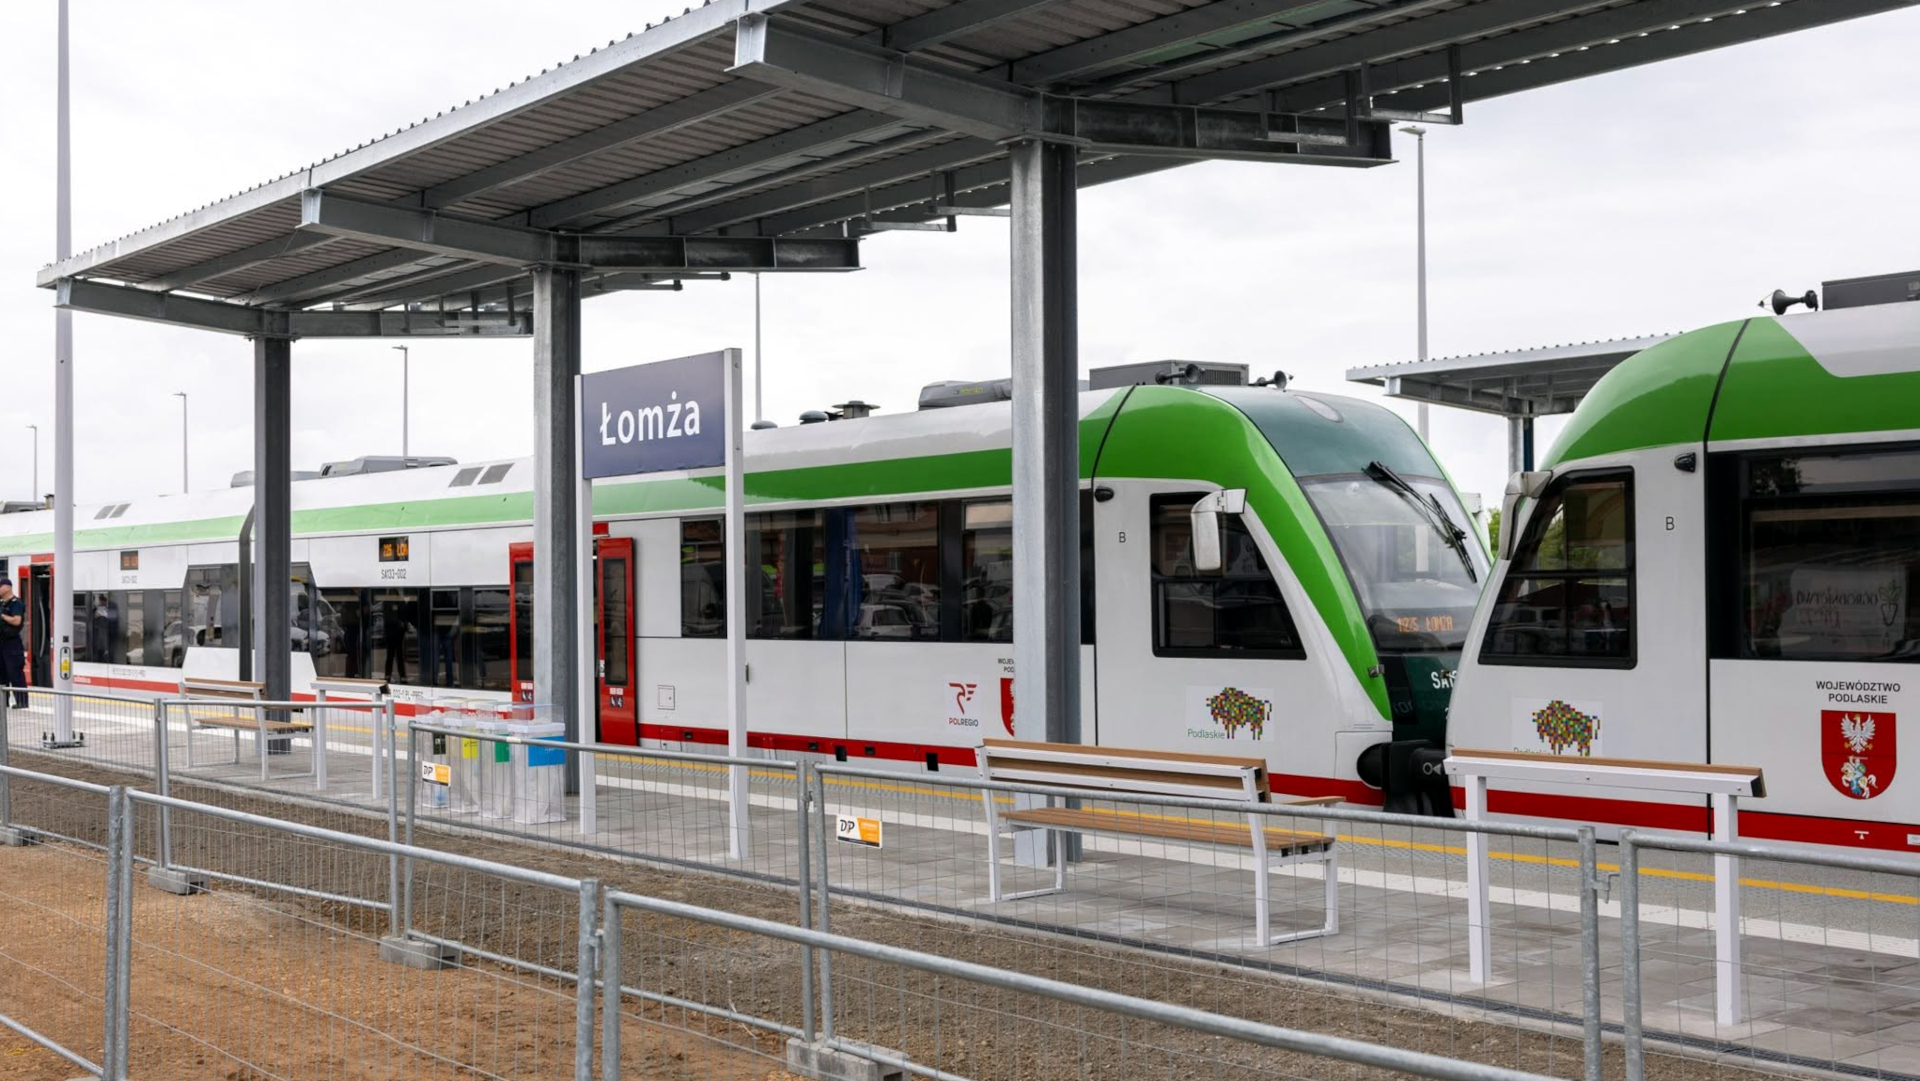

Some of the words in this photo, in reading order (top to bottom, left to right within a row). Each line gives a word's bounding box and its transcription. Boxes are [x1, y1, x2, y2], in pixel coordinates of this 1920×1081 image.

[599, 390, 700, 446] Łomża
[1665, 516, 1675, 531] B
[1118, 531, 1127, 543] B
[1816, 680, 1901, 692] WOJEWÓDZTWO
[1828, 693, 1888, 704] PODLASKIE
[948, 717, 979, 727] POLREGIO
[1187, 728, 1226, 740] Podlaskie
